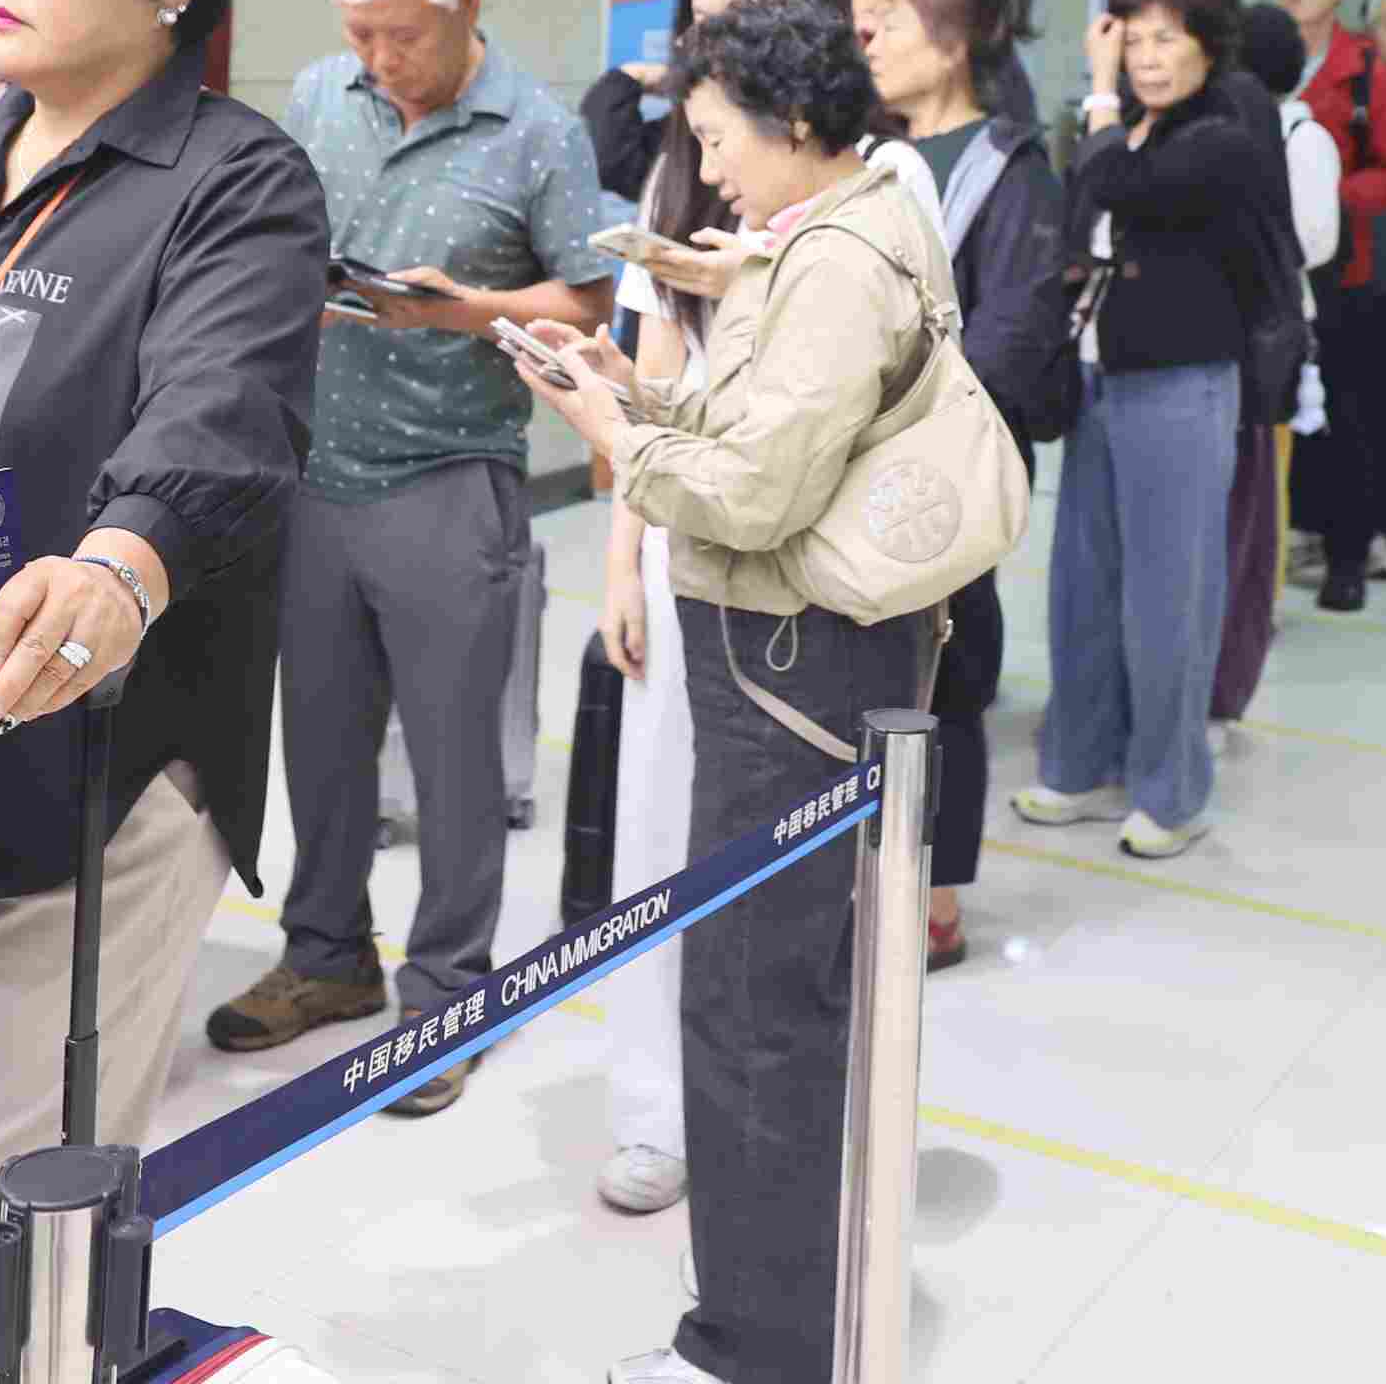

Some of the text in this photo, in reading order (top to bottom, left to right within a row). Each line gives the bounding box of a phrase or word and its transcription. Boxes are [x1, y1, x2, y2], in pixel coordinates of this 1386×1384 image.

[773, 774, 860, 846] 中国移民管理
[500, 888, 672, 1007] CHINA IMMIGRATION
[342, 988, 486, 1093] 中国移民管理
